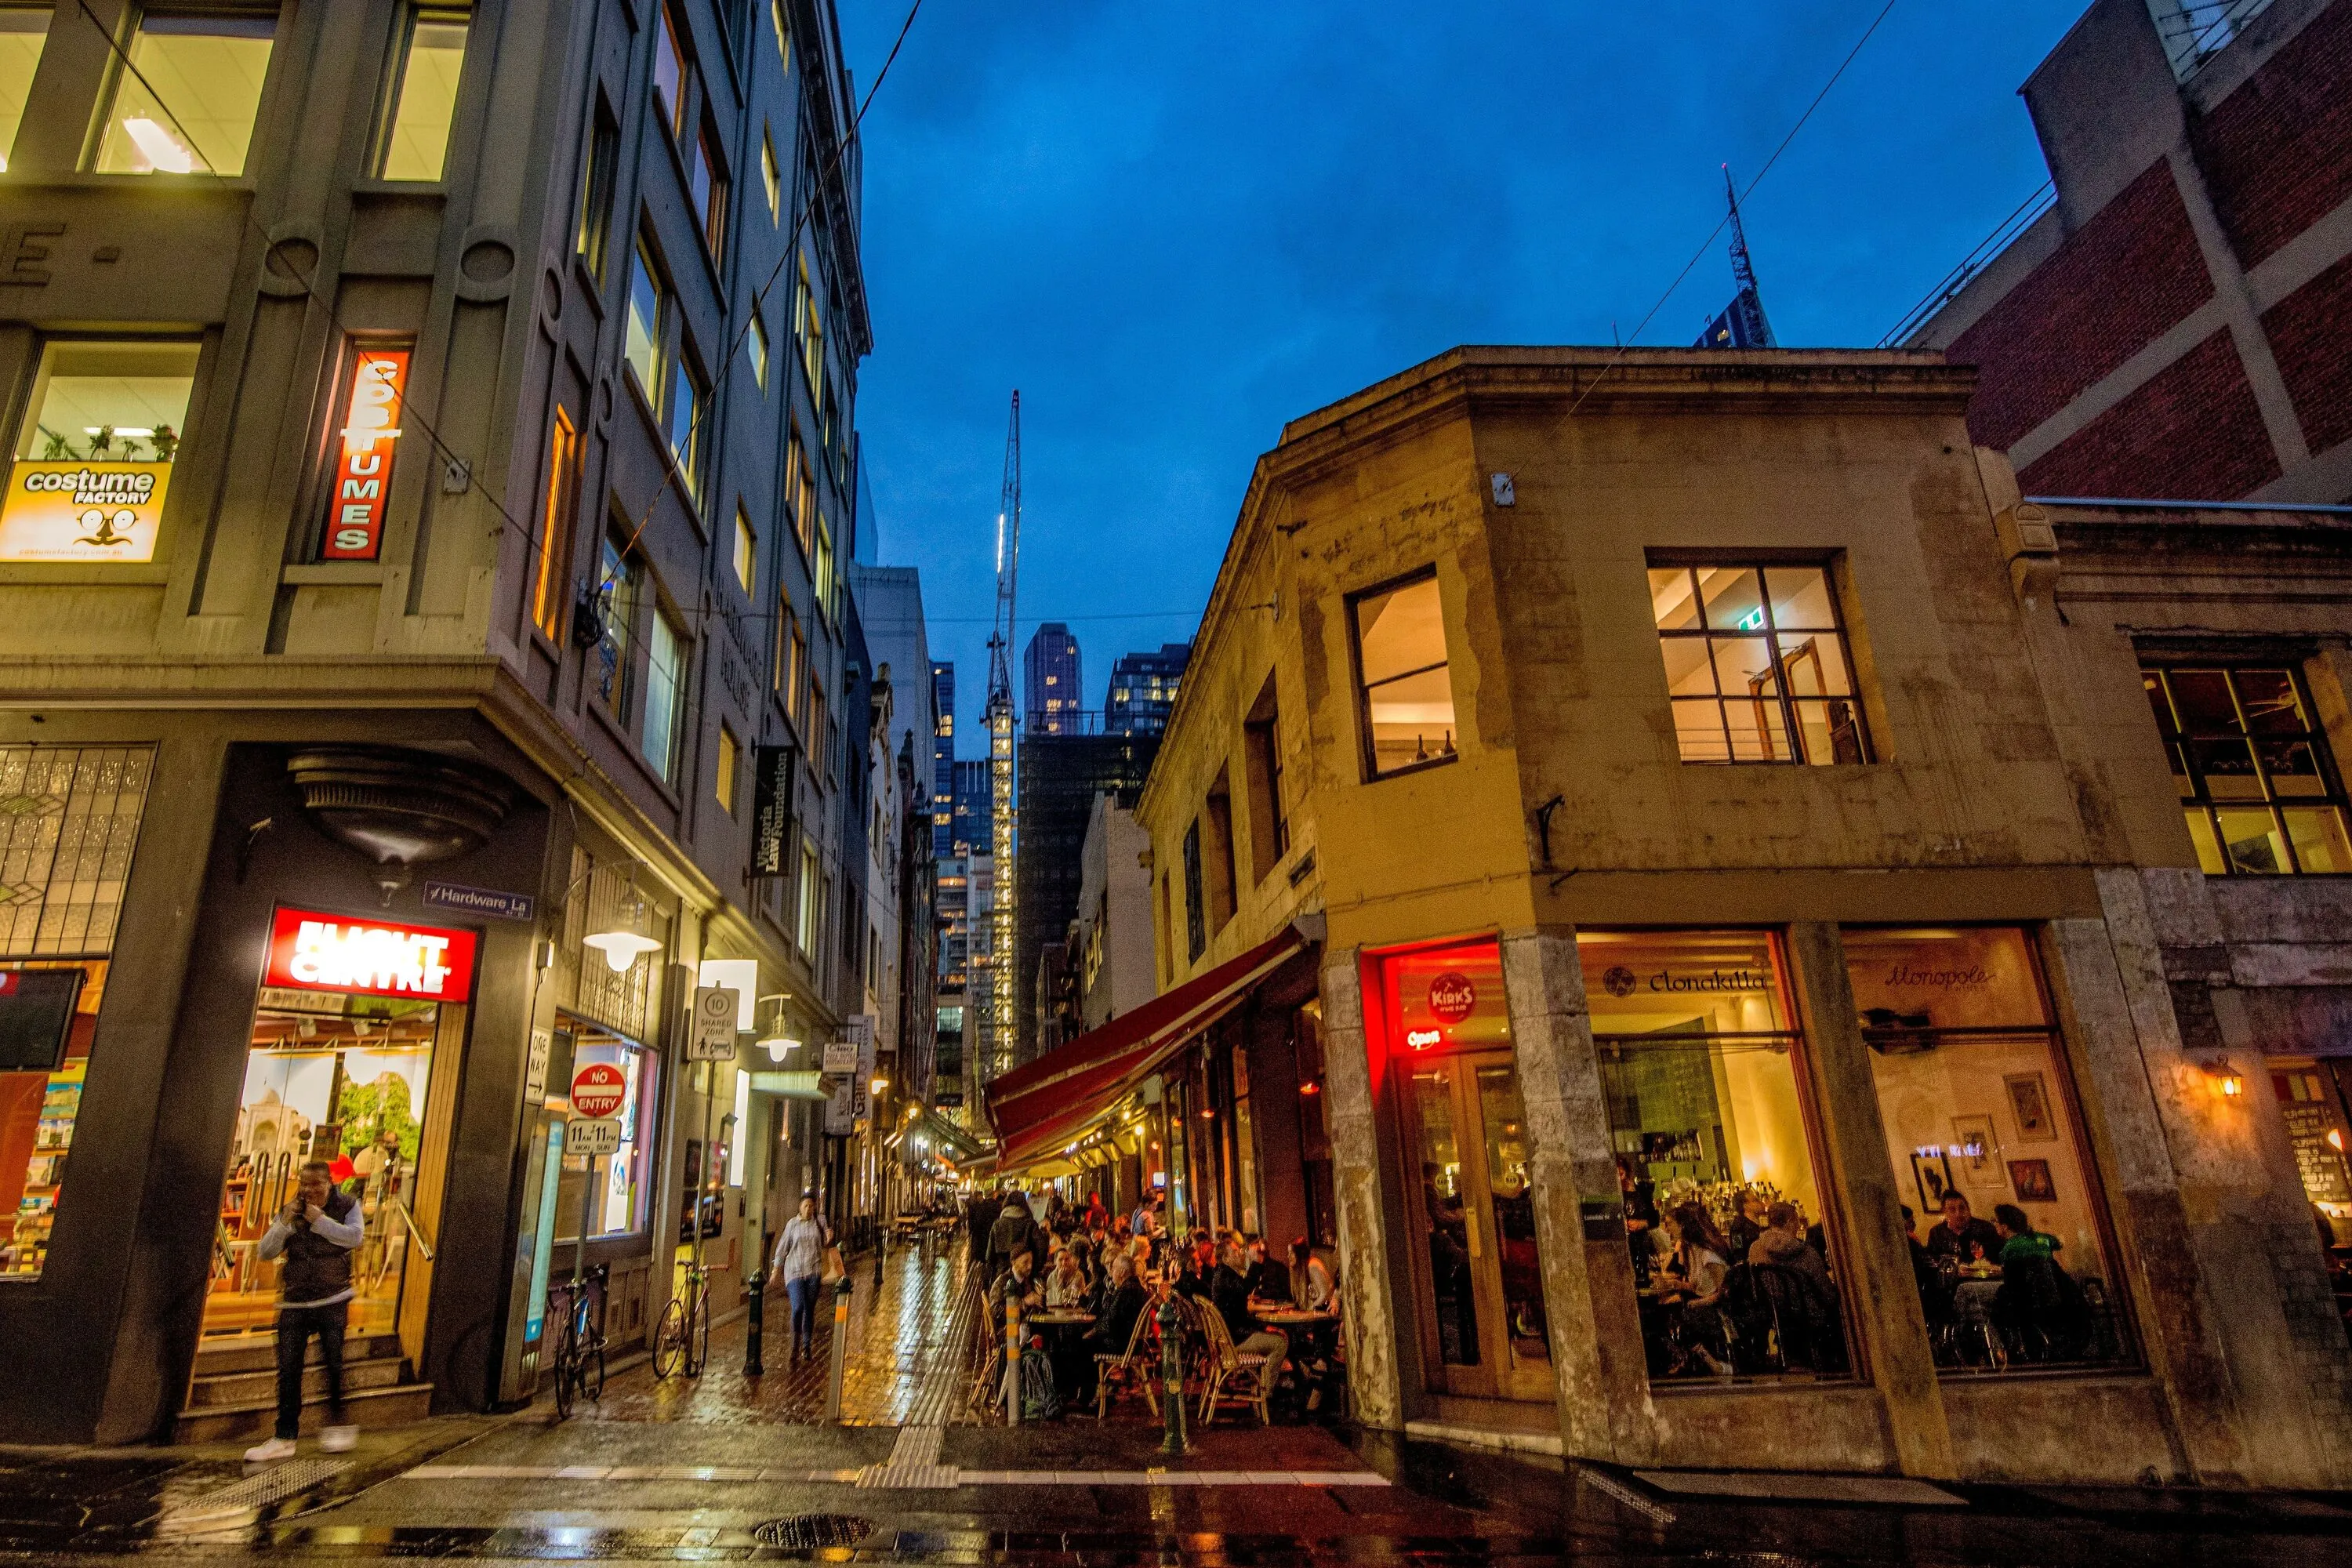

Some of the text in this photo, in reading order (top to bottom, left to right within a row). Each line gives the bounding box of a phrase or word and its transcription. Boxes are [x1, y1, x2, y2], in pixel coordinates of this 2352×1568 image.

[334, 360, 401, 550] COSTUMES
[25, 468, 154, 492] costume
[74, 492, 151, 505] FACTORY
[757, 805, 772, 867] Victoria
[441, 887, 506, 909] Hardware
[289, 950, 446, 994] CENTRE
[1649, 969, 1767, 992] Clonakilla
[712, 999, 724, 1011] 10
[701, 1019, 731, 1028] SHARED
[532, 1036, 547, 1054] ONE
[1407, 1030, 1441, 1051] Open
[530, 1058, 546, 1076] WAY
[591, 1071, 608, 1084] NO
[578, 1098, 618, 1110] ENTRY
[575, 1144, 611, 1153] MON SUN
